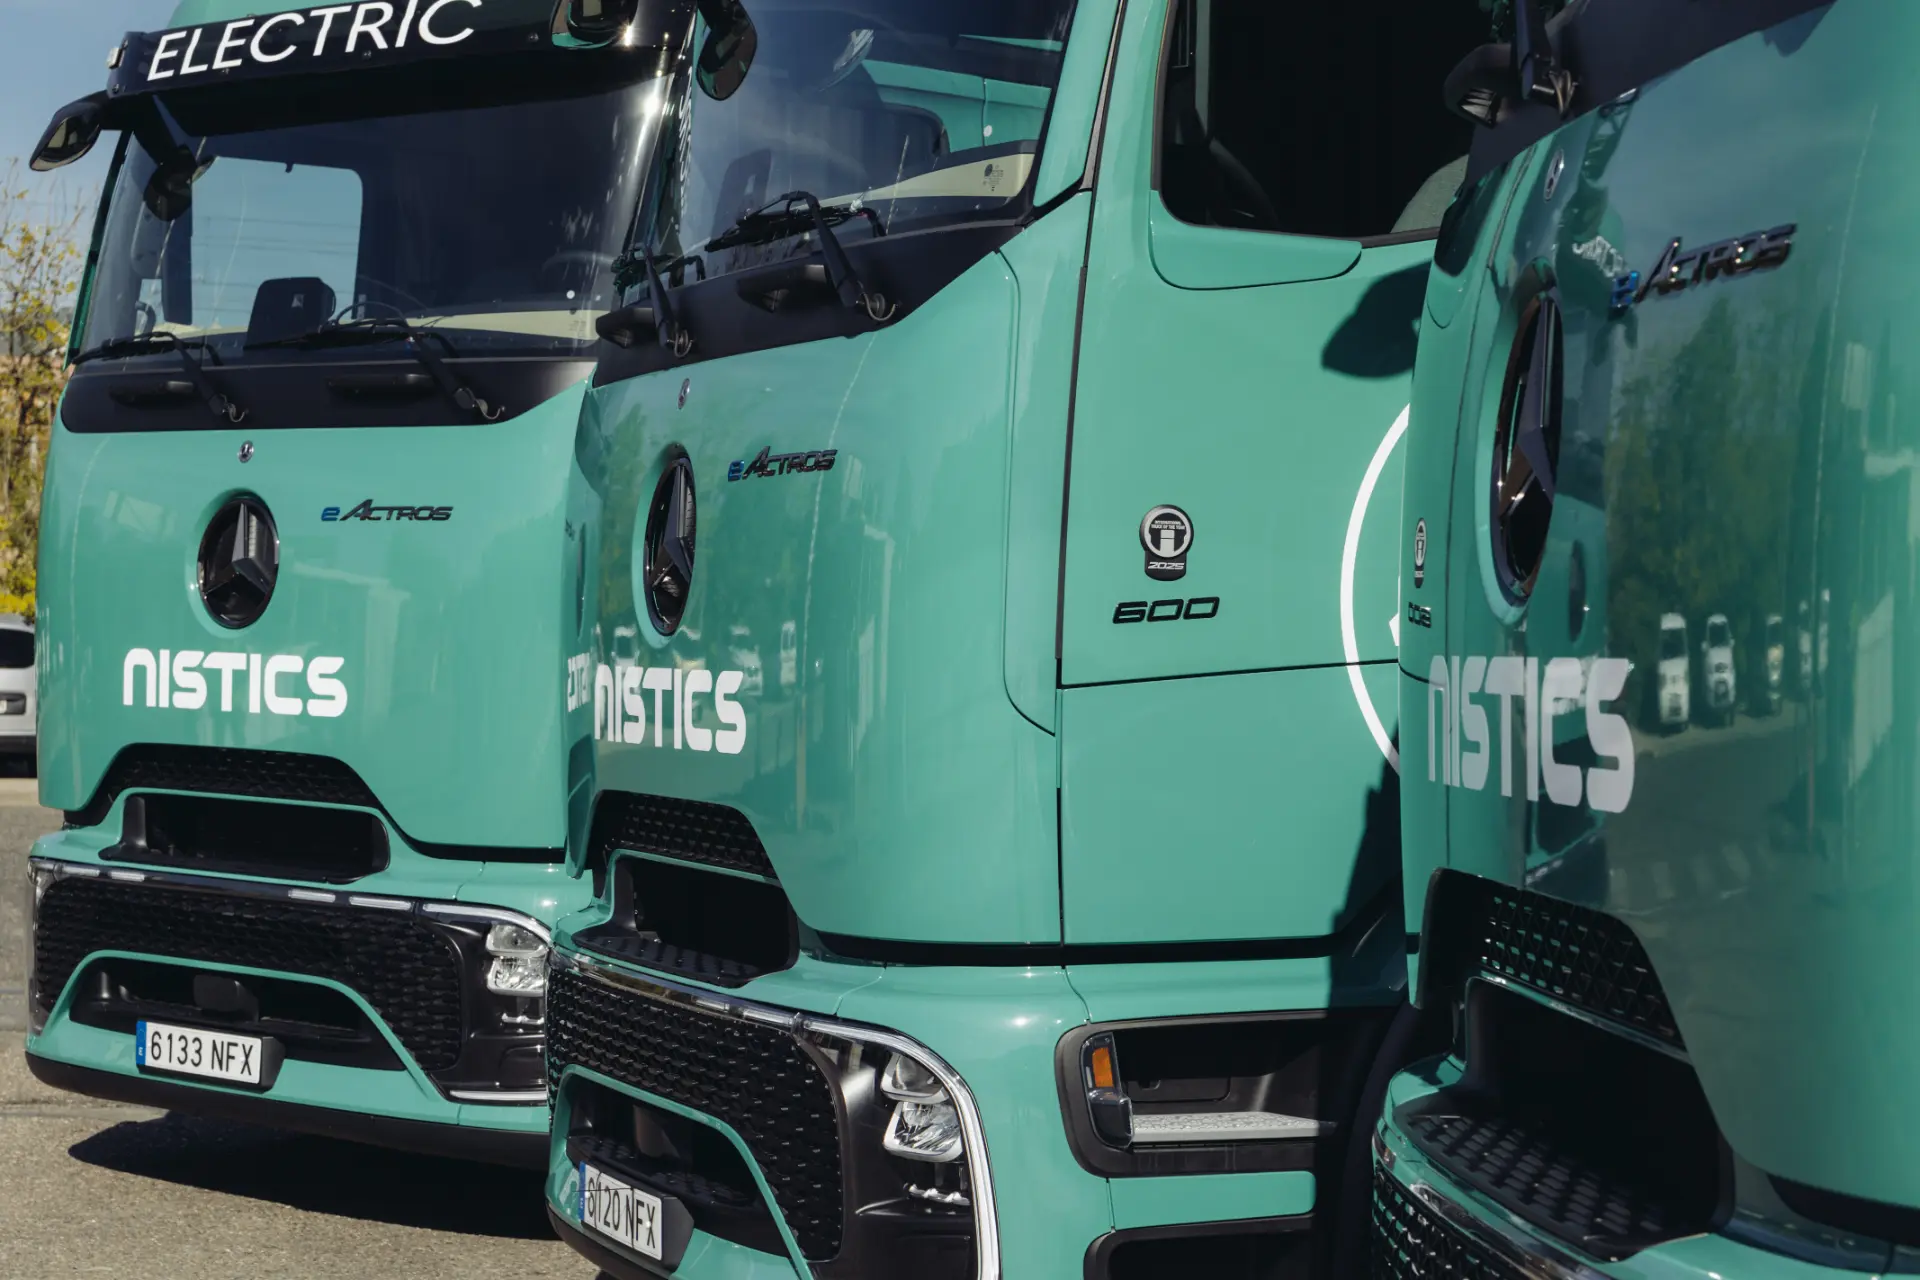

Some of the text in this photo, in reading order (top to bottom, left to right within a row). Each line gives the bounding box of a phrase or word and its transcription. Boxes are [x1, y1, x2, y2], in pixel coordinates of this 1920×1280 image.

[147, 0, 482, 82] ELECTRIC
[1147, 561, 1185, 570] 2025
[1112, 596, 1220, 624] 600
[151, 1031, 203, 1067] 6133
[211, 1039, 254, 1076] NFX
[587, 1177, 656, 1249] 6120 NFX
